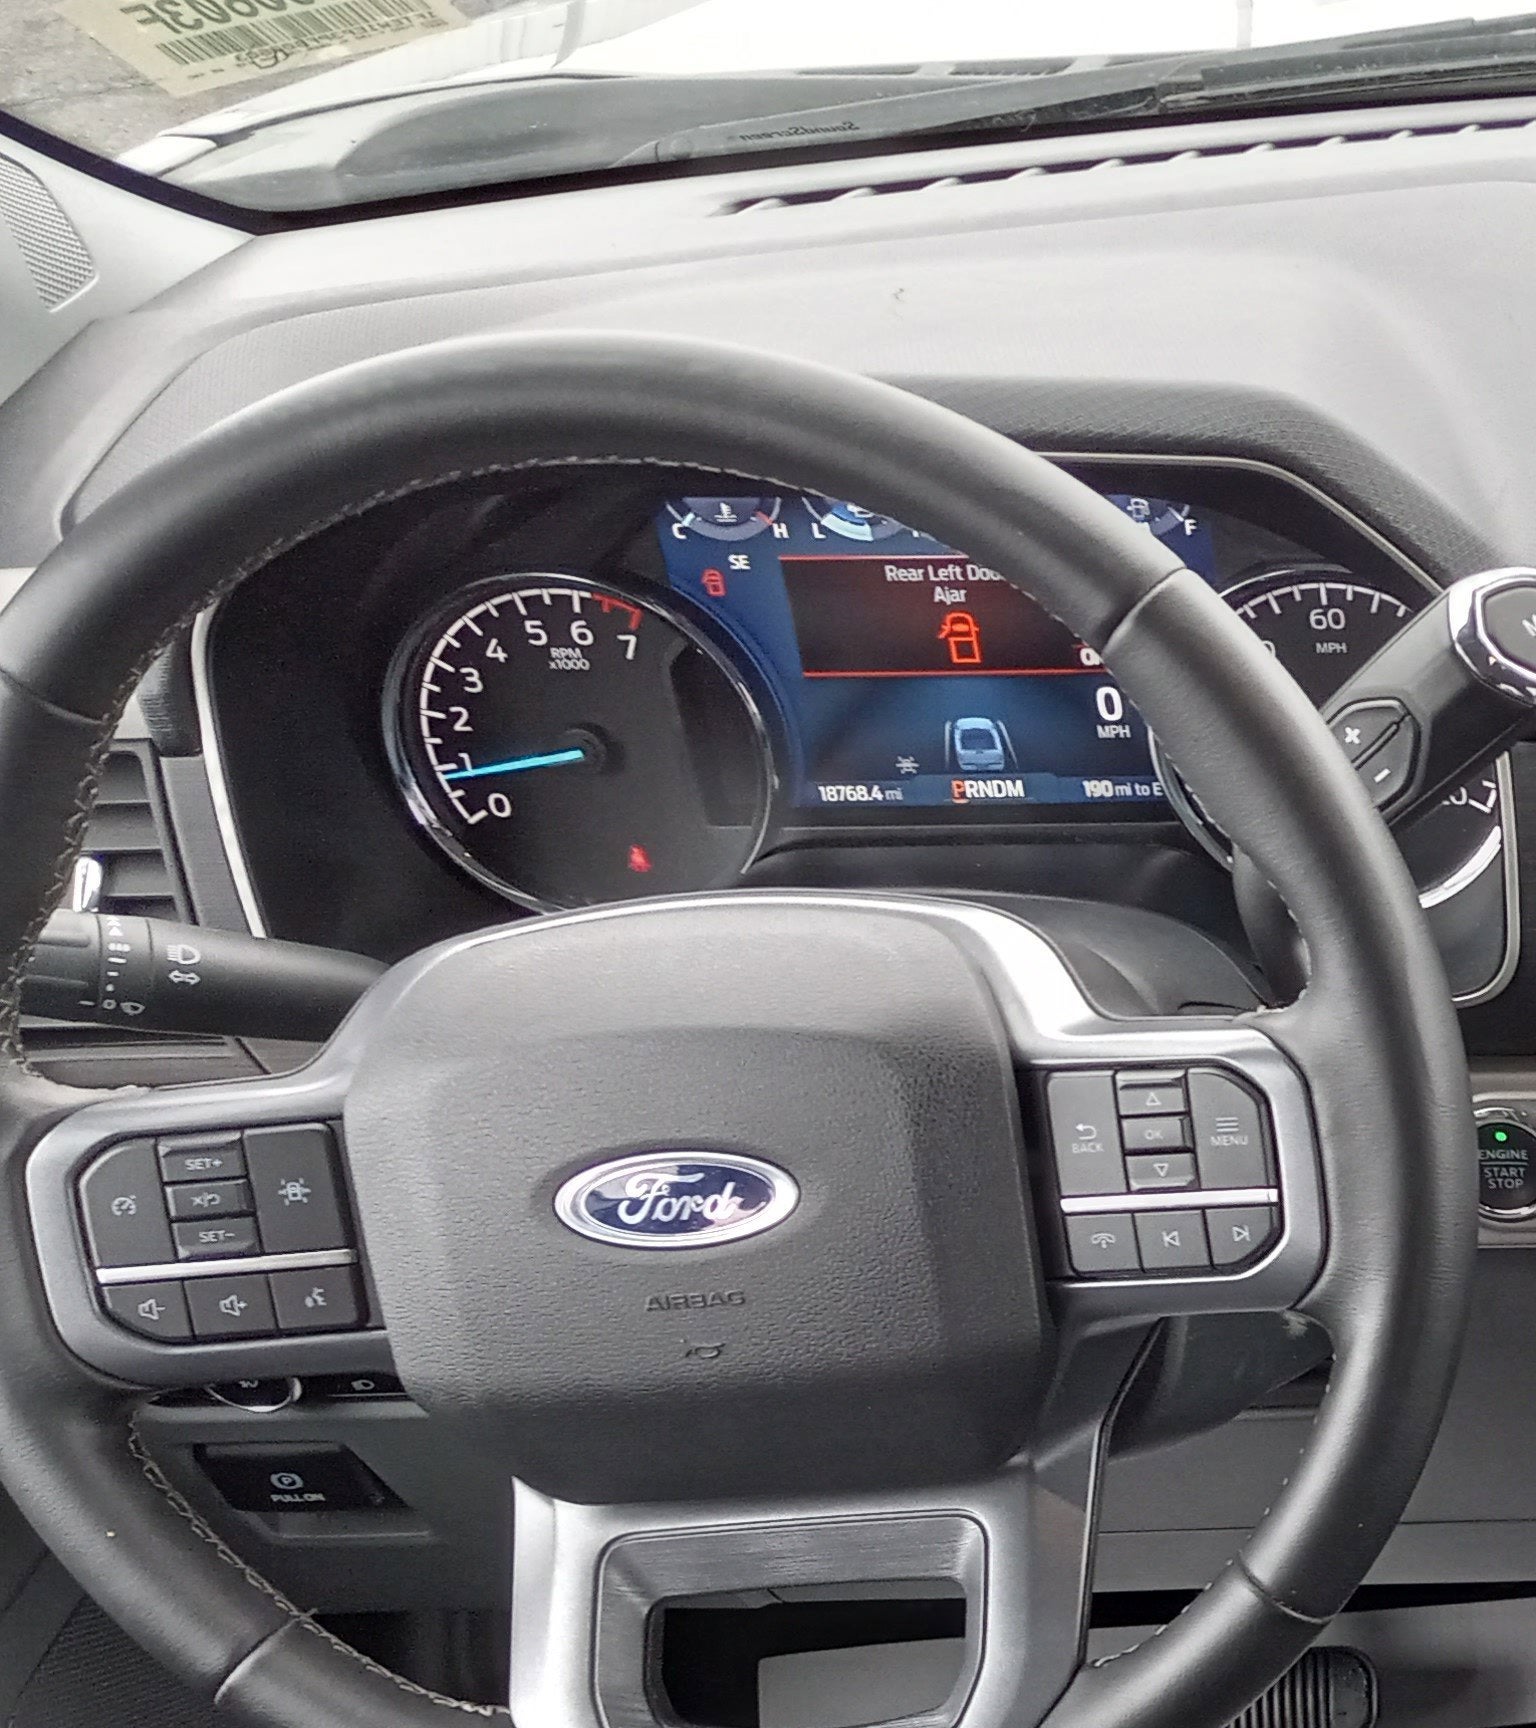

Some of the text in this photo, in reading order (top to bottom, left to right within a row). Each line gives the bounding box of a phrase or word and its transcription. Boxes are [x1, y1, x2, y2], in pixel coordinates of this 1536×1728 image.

[672, 523, 687, 539] C
[774, 523, 789, 539] H
[812, 523, 826, 539] L
[1184, 518, 1197, 535] F
[728, 554, 751, 569] SE
[884, 564, 1003, 582] Rear Left Doo
[933, 586, 967, 605] Ajar
[1309, 607, 1346, 630] 60
[524, 620, 547, 645] 5
[570, 620, 594, 646] 6
[486, 639, 507, 663] 4
[549, 647, 582, 659] RPM
[617, 634, 638, 660] 7
[1316, 642, 1347, 654] MPH
[549, 659, 590, 671] x1000
[460, 667, 483, 693] 3
[1095, 686, 1123, 722] 0
[450, 707, 473, 732] 2
[1097, 724, 1131, 739] MPH
[818, 784, 903, 802] 18768.4 mi
[1082, 780, 1164, 798] 190 mi to E
[488, 793, 512, 818] 0
[1144, 1129, 1164, 1141] OK
[1210, 1135, 1249, 1147] MENU
[1071, 1142, 1105, 1154] BACK
[1479, 1149, 1528, 1160] ENGINE
[1484, 1167, 1525, 1178] START
[1488, 1178, 1523, 1189] STOP
[617, 1172, 766, 1225] Ford
[646, 1290, 745, 1312] AIRBAG
